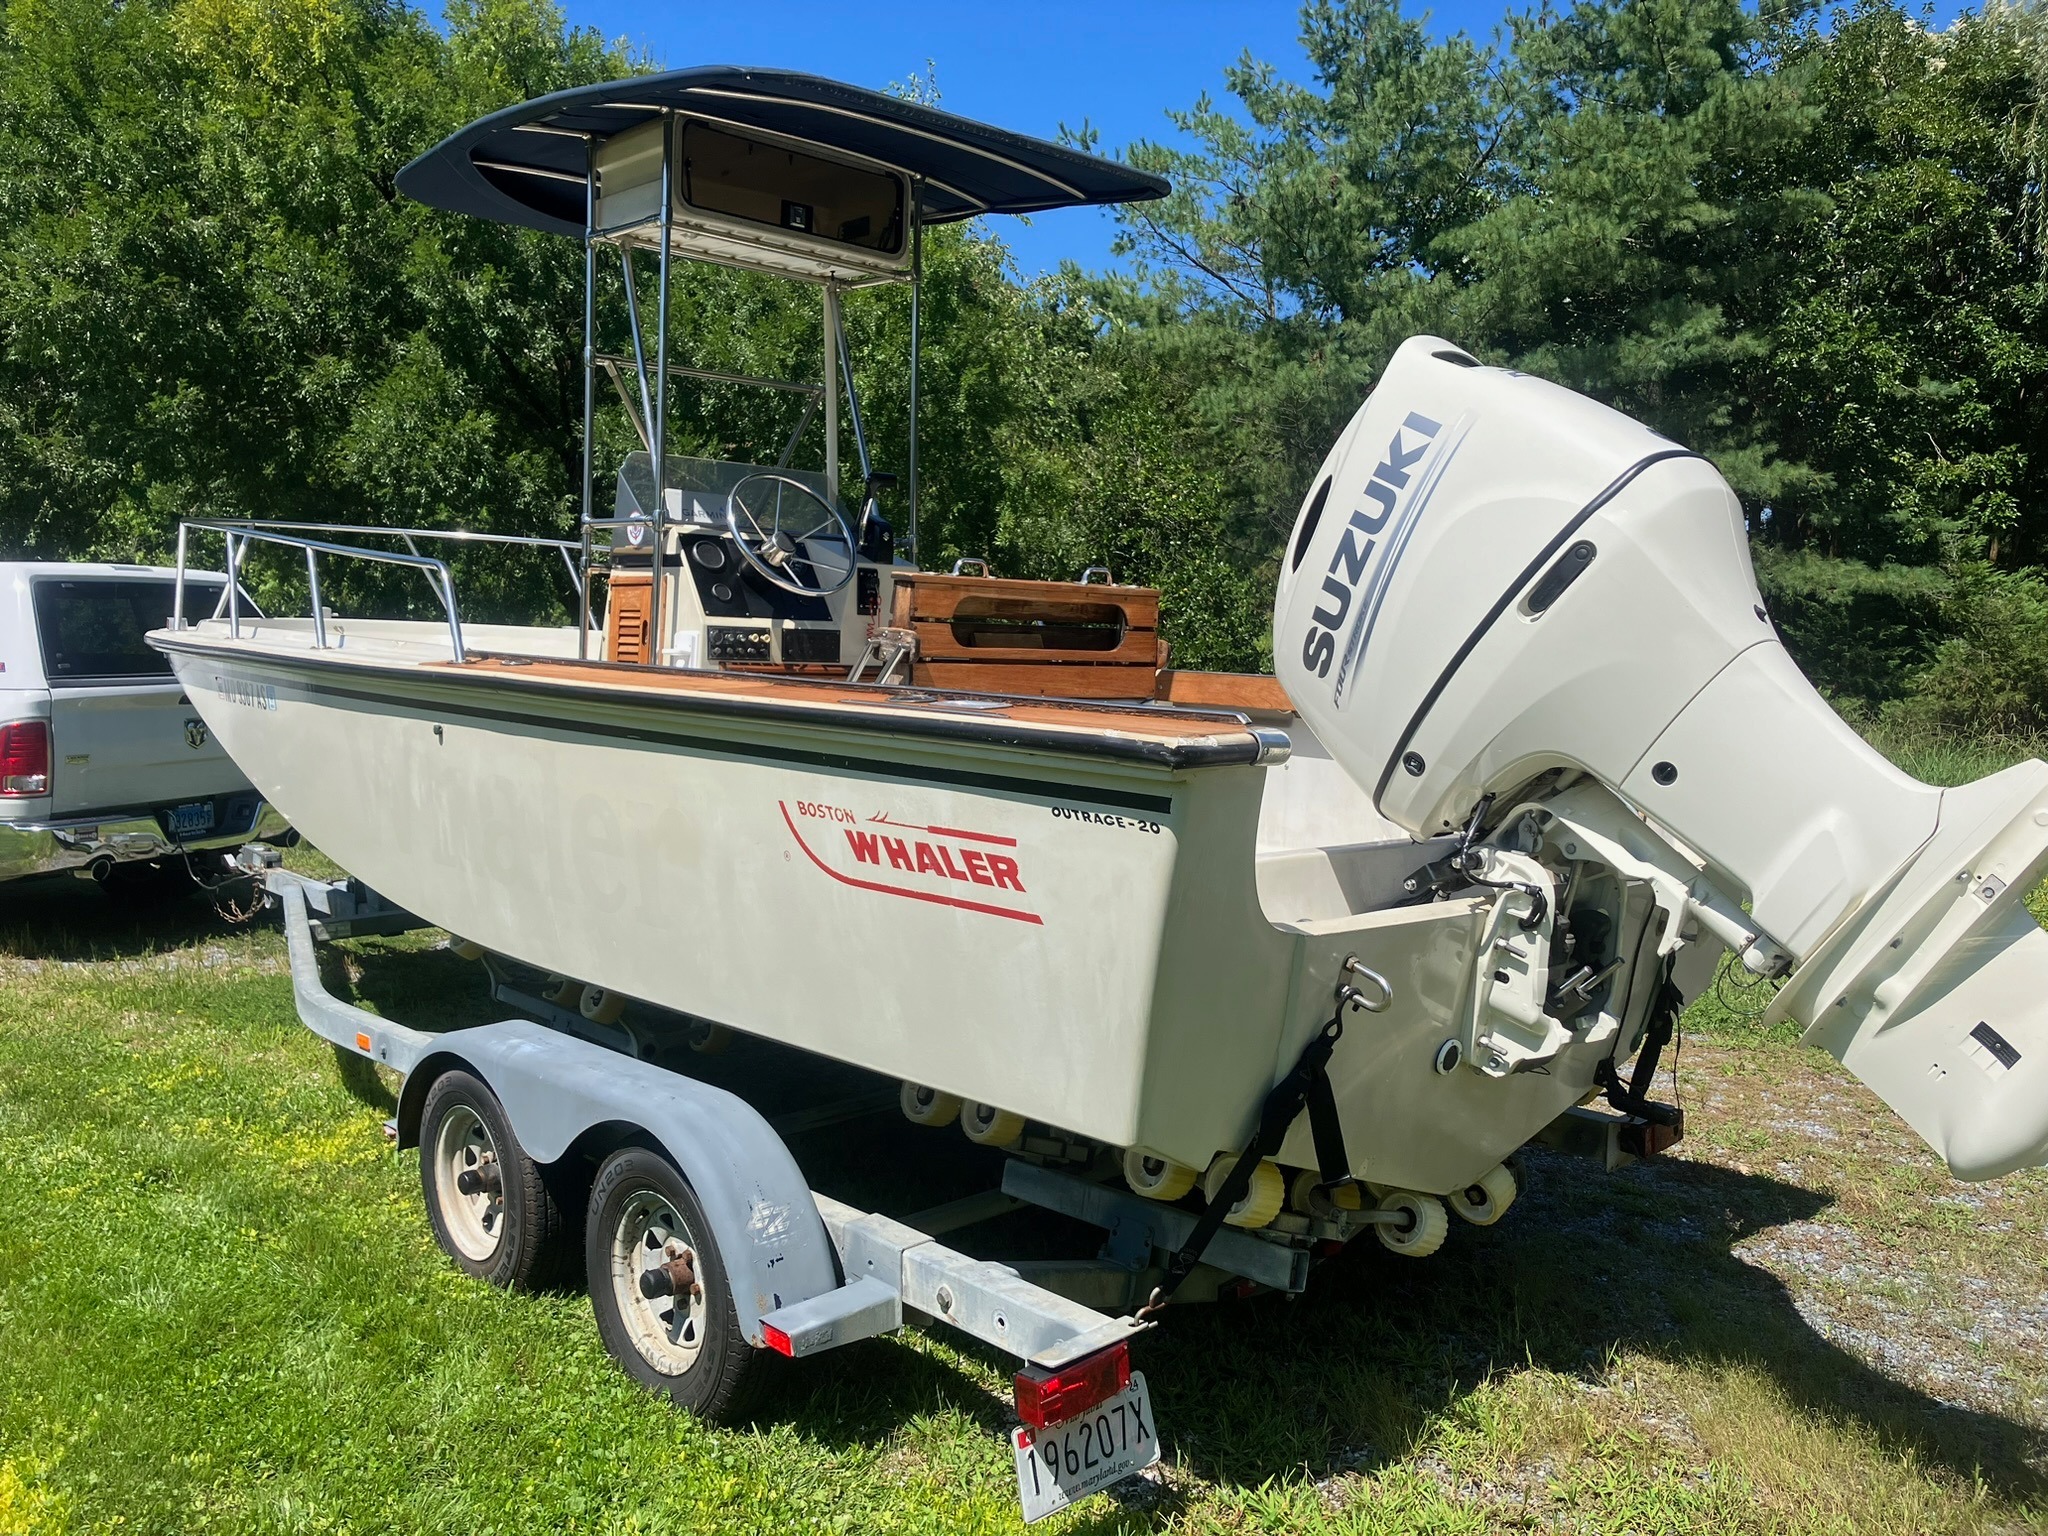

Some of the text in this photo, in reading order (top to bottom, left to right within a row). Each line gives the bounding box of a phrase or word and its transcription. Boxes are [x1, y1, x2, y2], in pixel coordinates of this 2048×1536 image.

[682, 508, 727, 519] GARMIN
[1302, 411, 1443, 679] SUZUKI
[796, 801, 856, 825] BOSTON
[843, 829, 1027, 893] WHALER
[1026, 1396, 1151, 1496] 196207X
